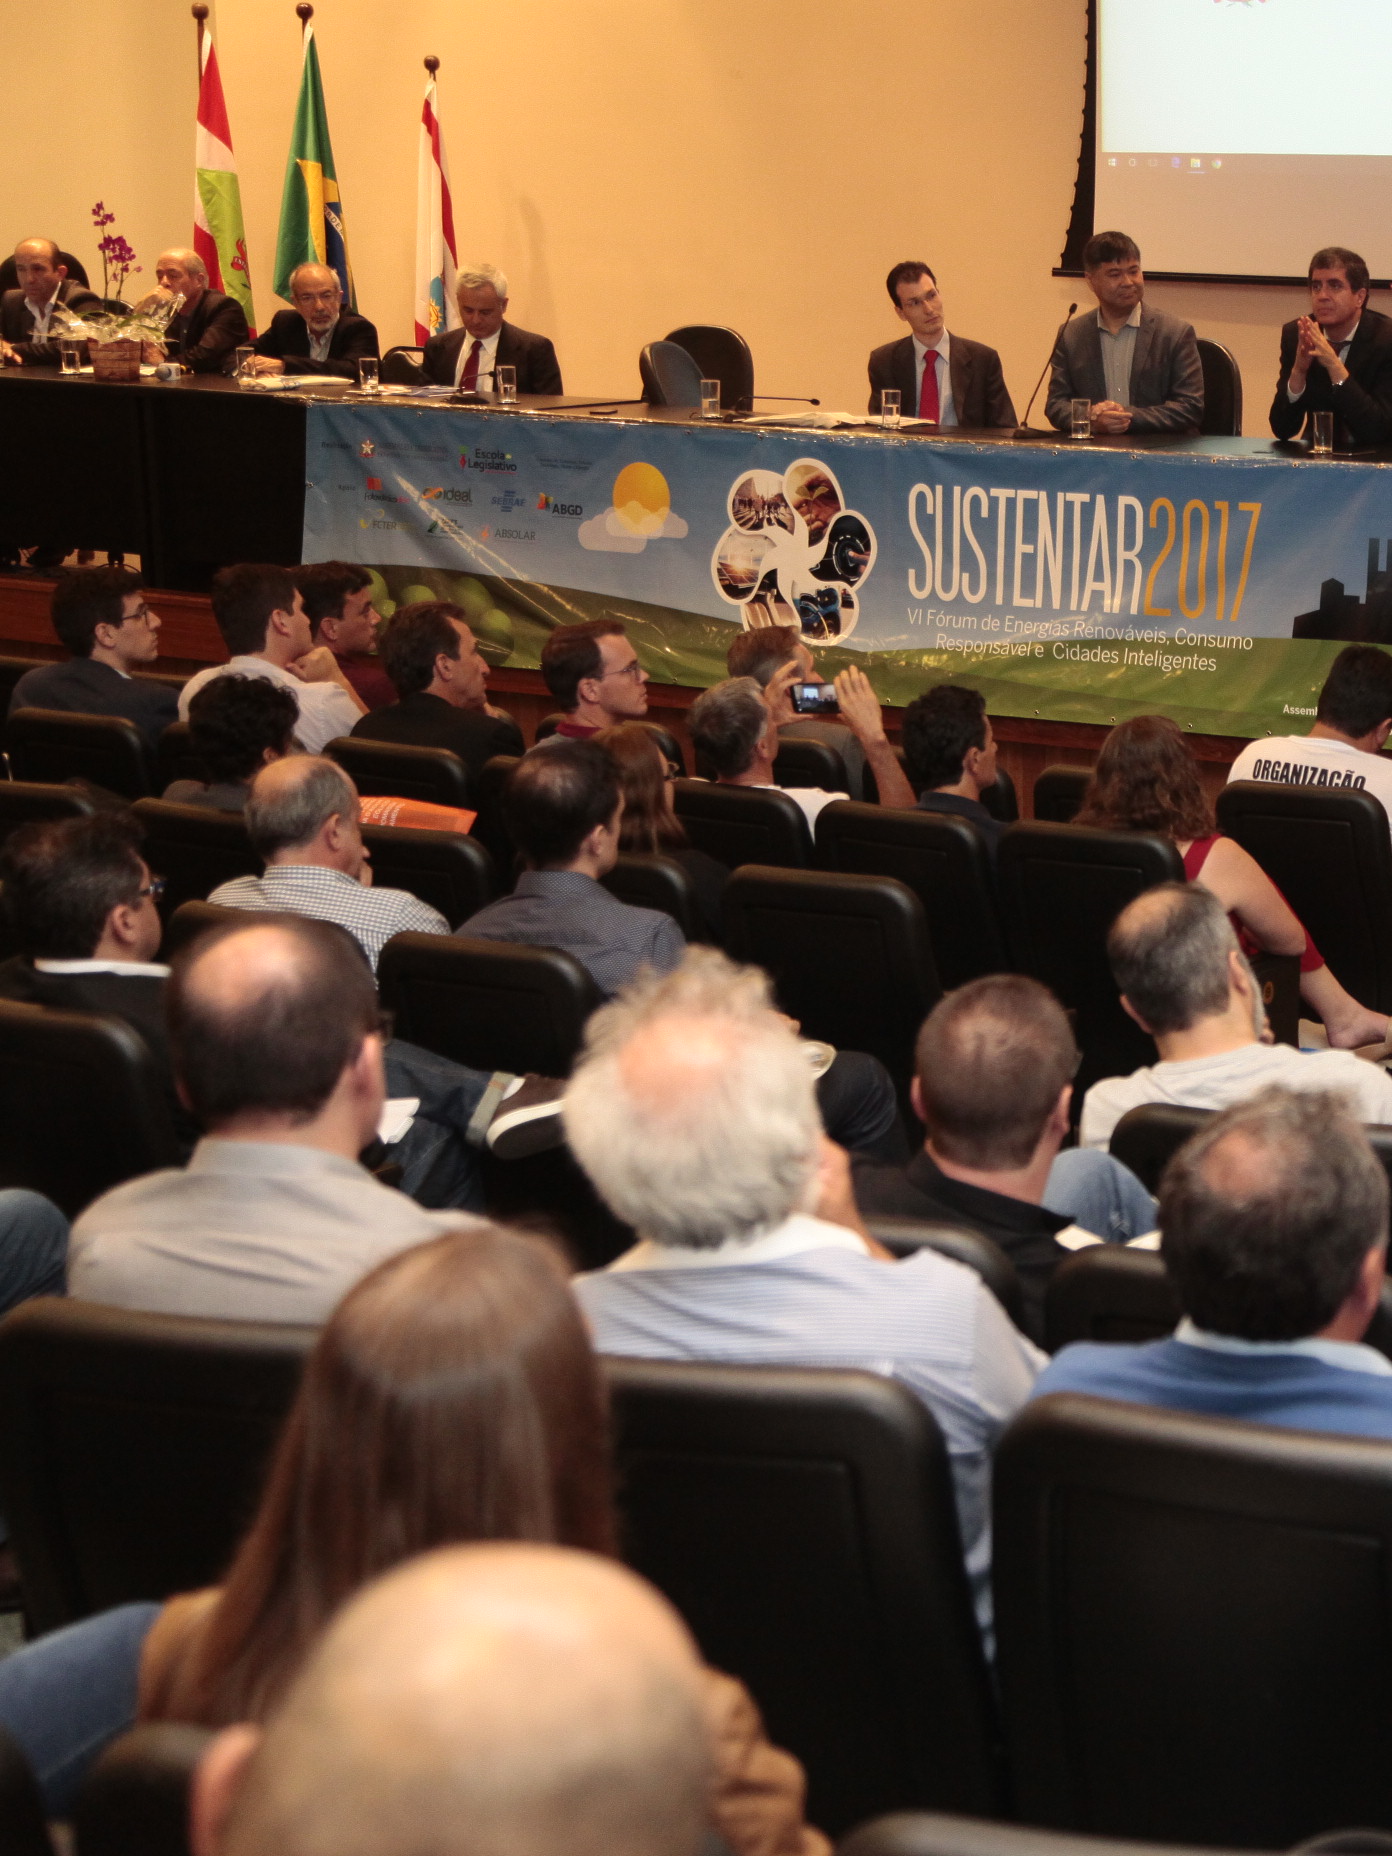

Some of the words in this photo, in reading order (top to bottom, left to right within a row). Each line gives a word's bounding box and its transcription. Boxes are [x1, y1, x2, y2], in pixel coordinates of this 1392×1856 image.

[475, 448, 505, 460] Escola
[468, 459, 517, 473] Legislativo
[491, 496, 526, 507] SEBRAE
[552, 503, 583, 517] ABGD
[495, 529, 536, 541] ABSOLAR
[907, 608, 922, 625] VI
[927, 608, 977, 631] Fórum
[981, 613, 1000, 632] de
[1004, 616, 1070, 640] Energias
[1074, 620, 1170, 646] Renováveis,
[1174, 627, 1254, 651] Consumo
[935, 634, 1033, 659] Responsável
[1034, 645, 1044, 658] e
[1052, 643, 1120, 665] Cidades
[1123, 651, 1217, 673] Inteligentes
